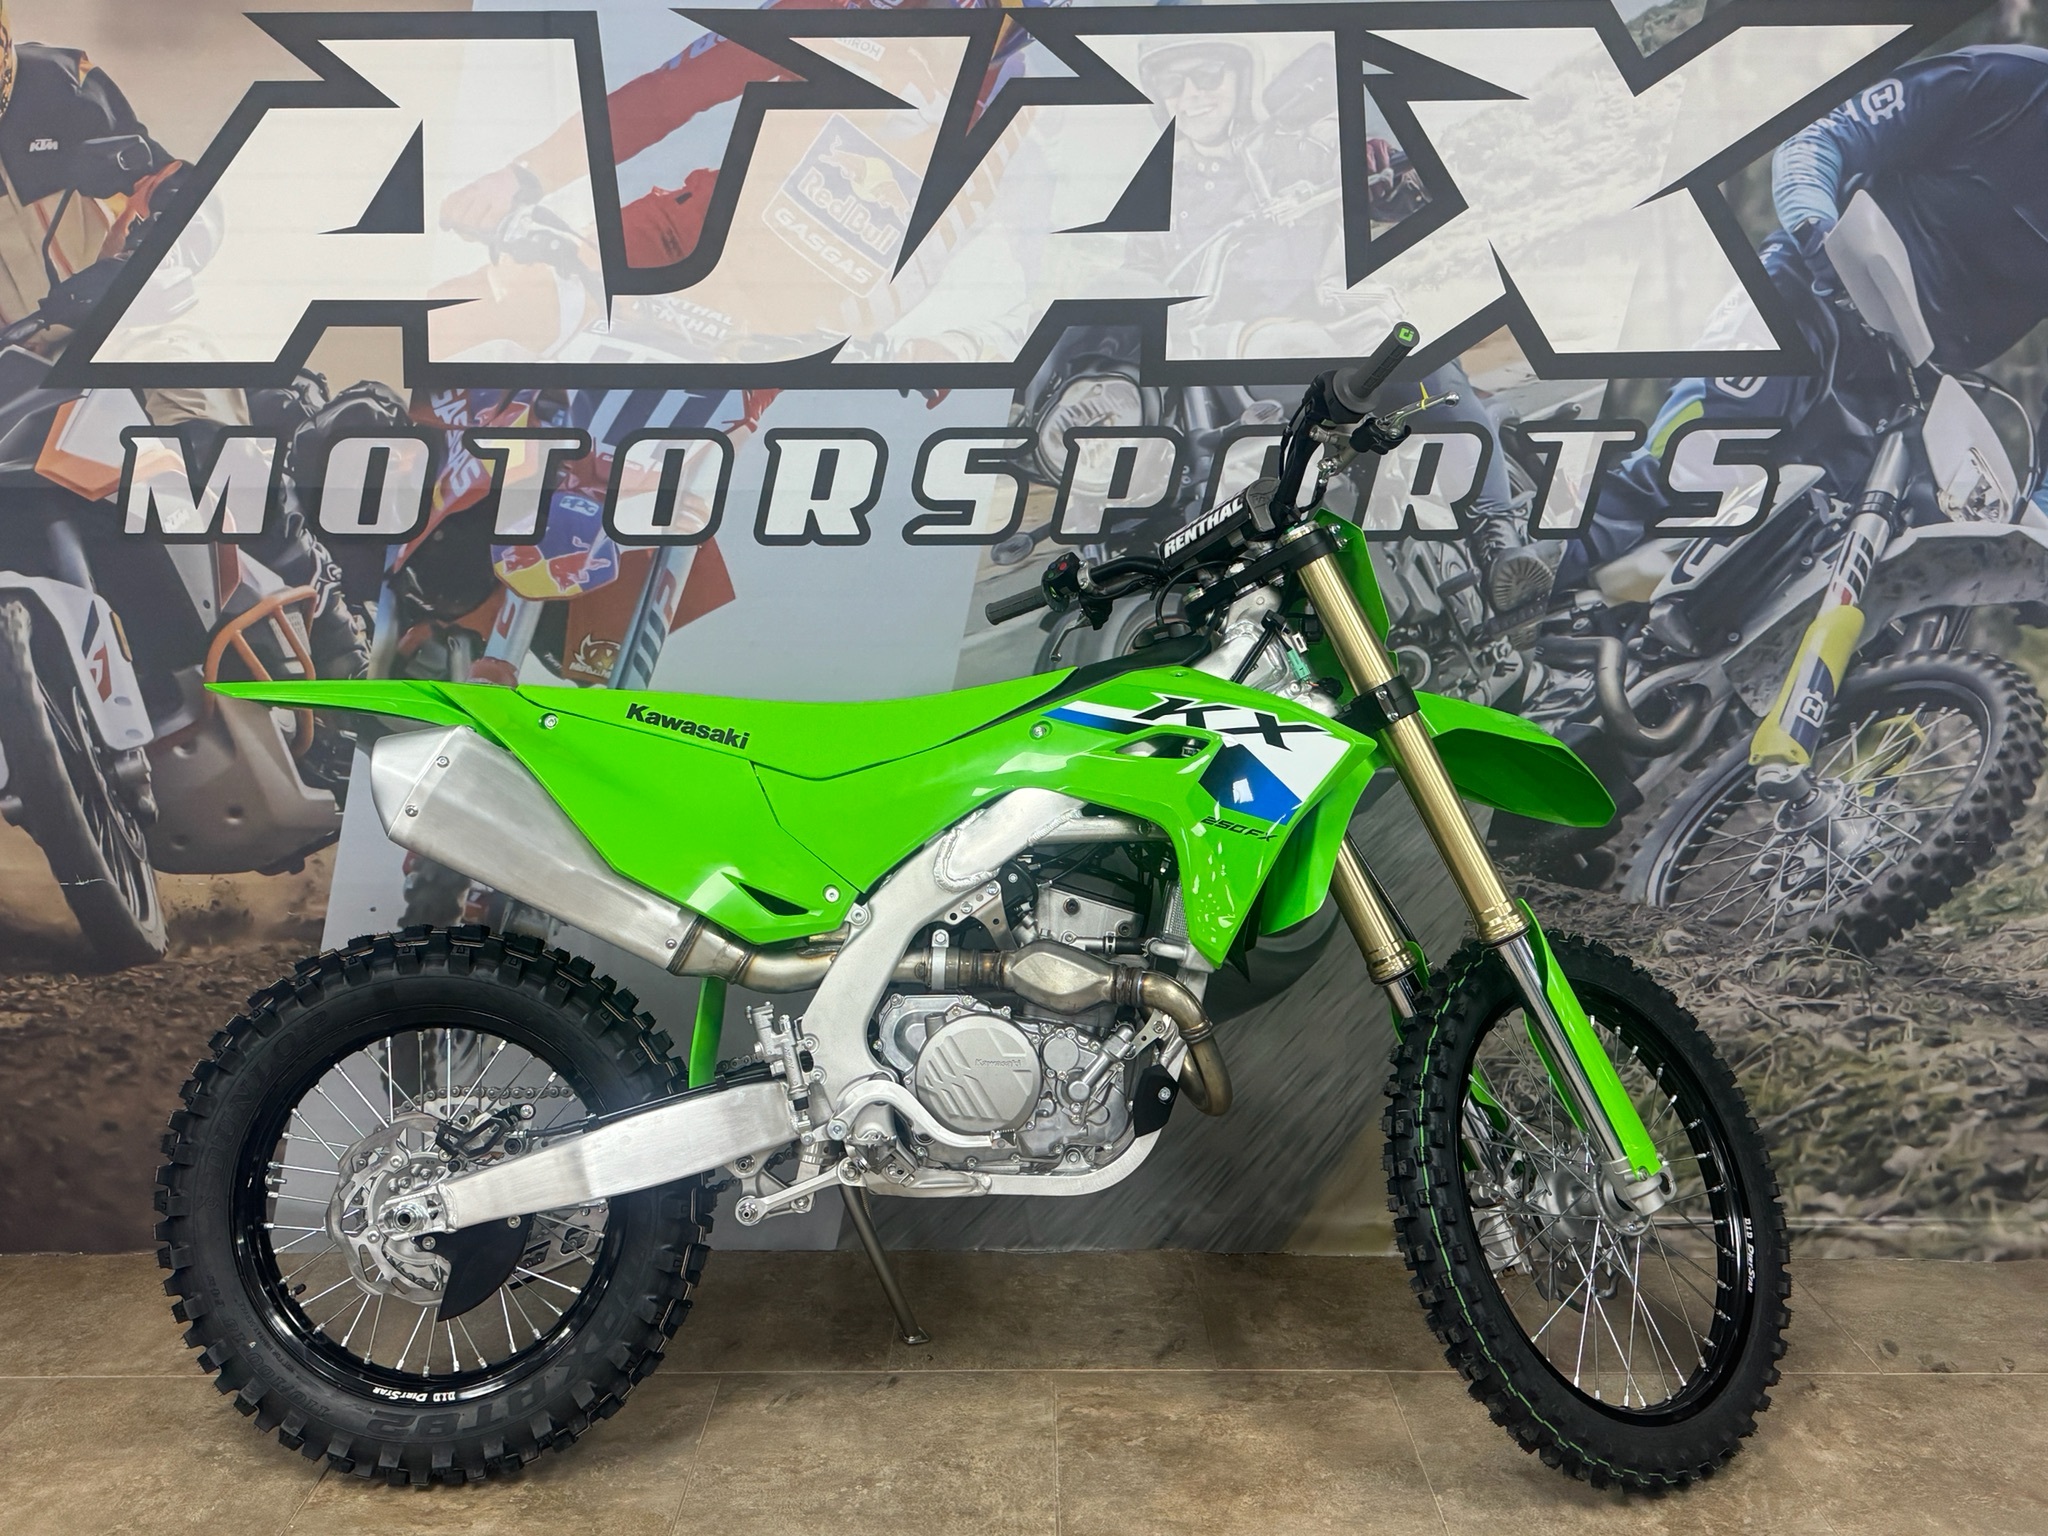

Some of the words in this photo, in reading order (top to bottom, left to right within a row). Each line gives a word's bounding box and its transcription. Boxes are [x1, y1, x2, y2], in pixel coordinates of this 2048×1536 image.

[29, 138, 59, 152] KTM
[41, 0, 1990, 390] AJAX
[774, 207, 873, 285] GASGAS
[1164, 497, 1243, 559] RENTHAL
[626, 703, 750, 750] Kawasaki
[1132, 696, 1327, 752] KX
[1200, 815, 1279, 843] 250FX
